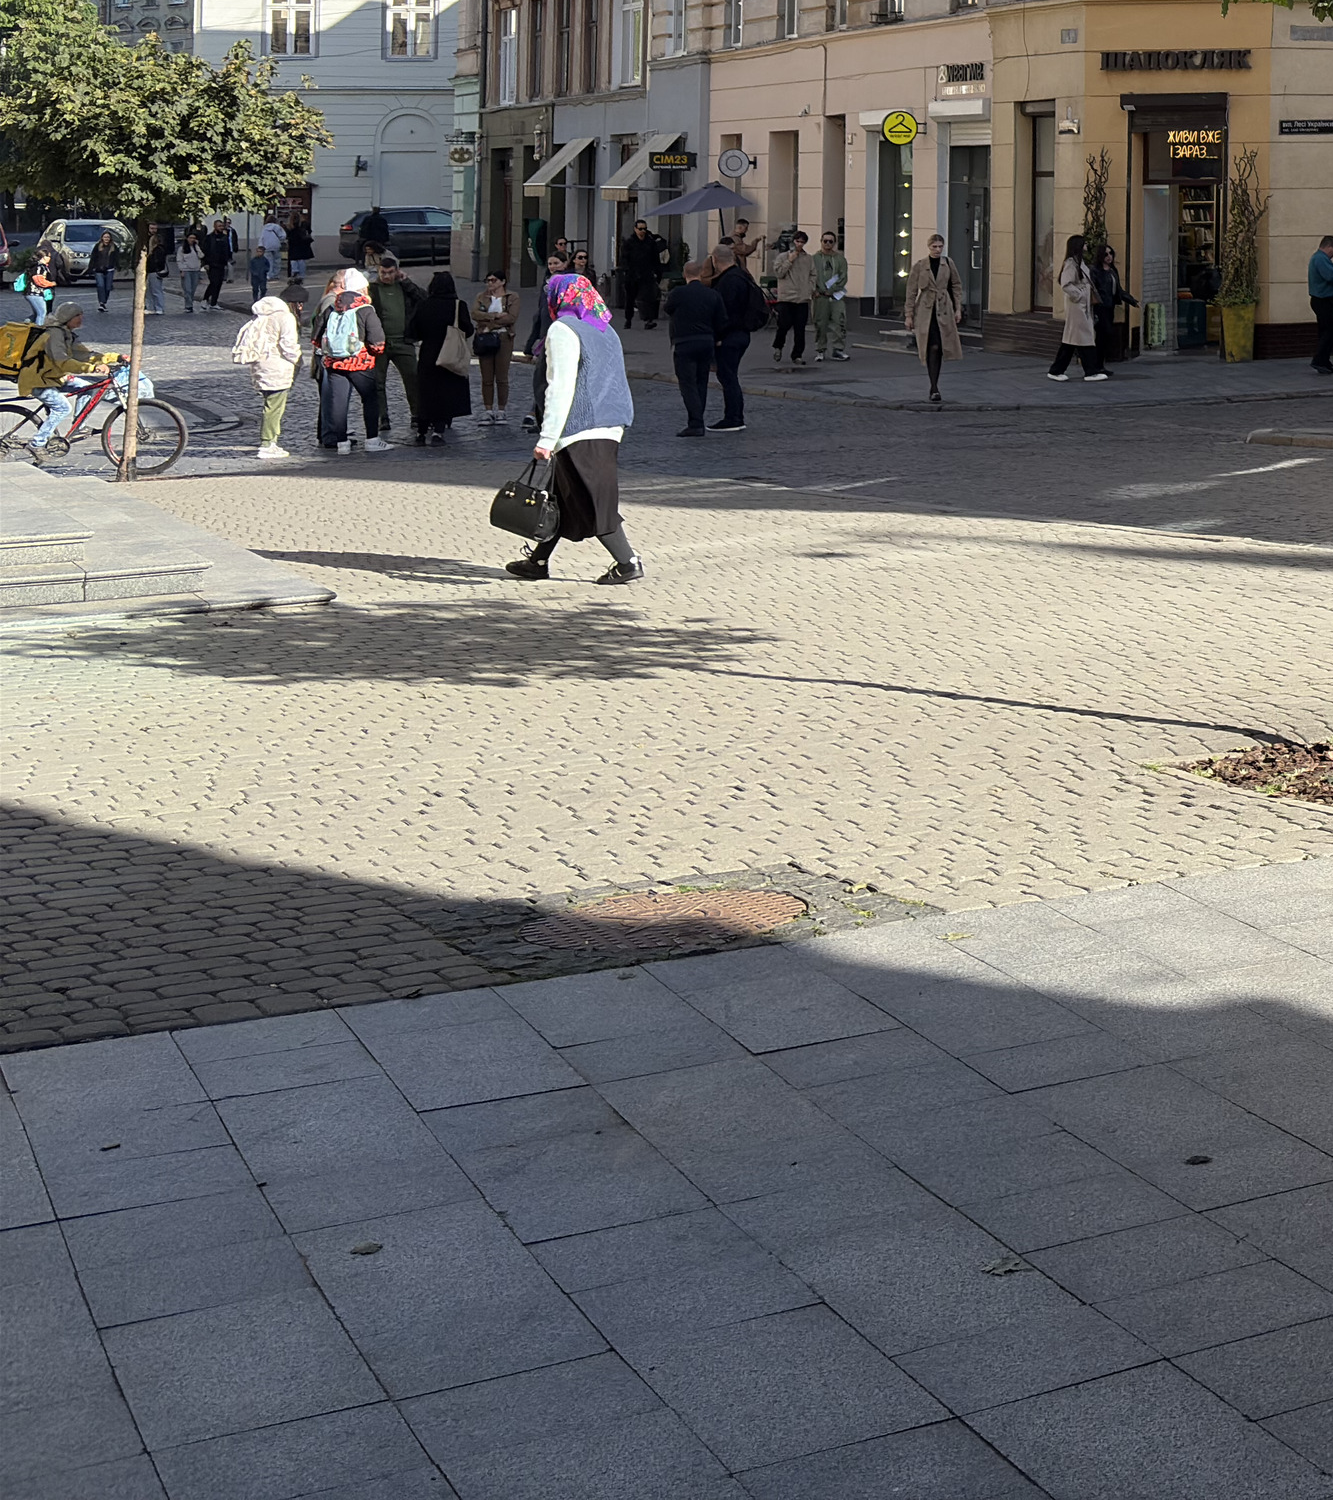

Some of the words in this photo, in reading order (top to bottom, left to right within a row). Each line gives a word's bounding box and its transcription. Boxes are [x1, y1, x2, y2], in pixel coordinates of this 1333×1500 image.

[1100, 50, 1252, 71] ШАПОКЛЯК
[1167, 130, 1197, 144] ЖИВИ
[1199, 130, 1222, 144] ВЖЕ
